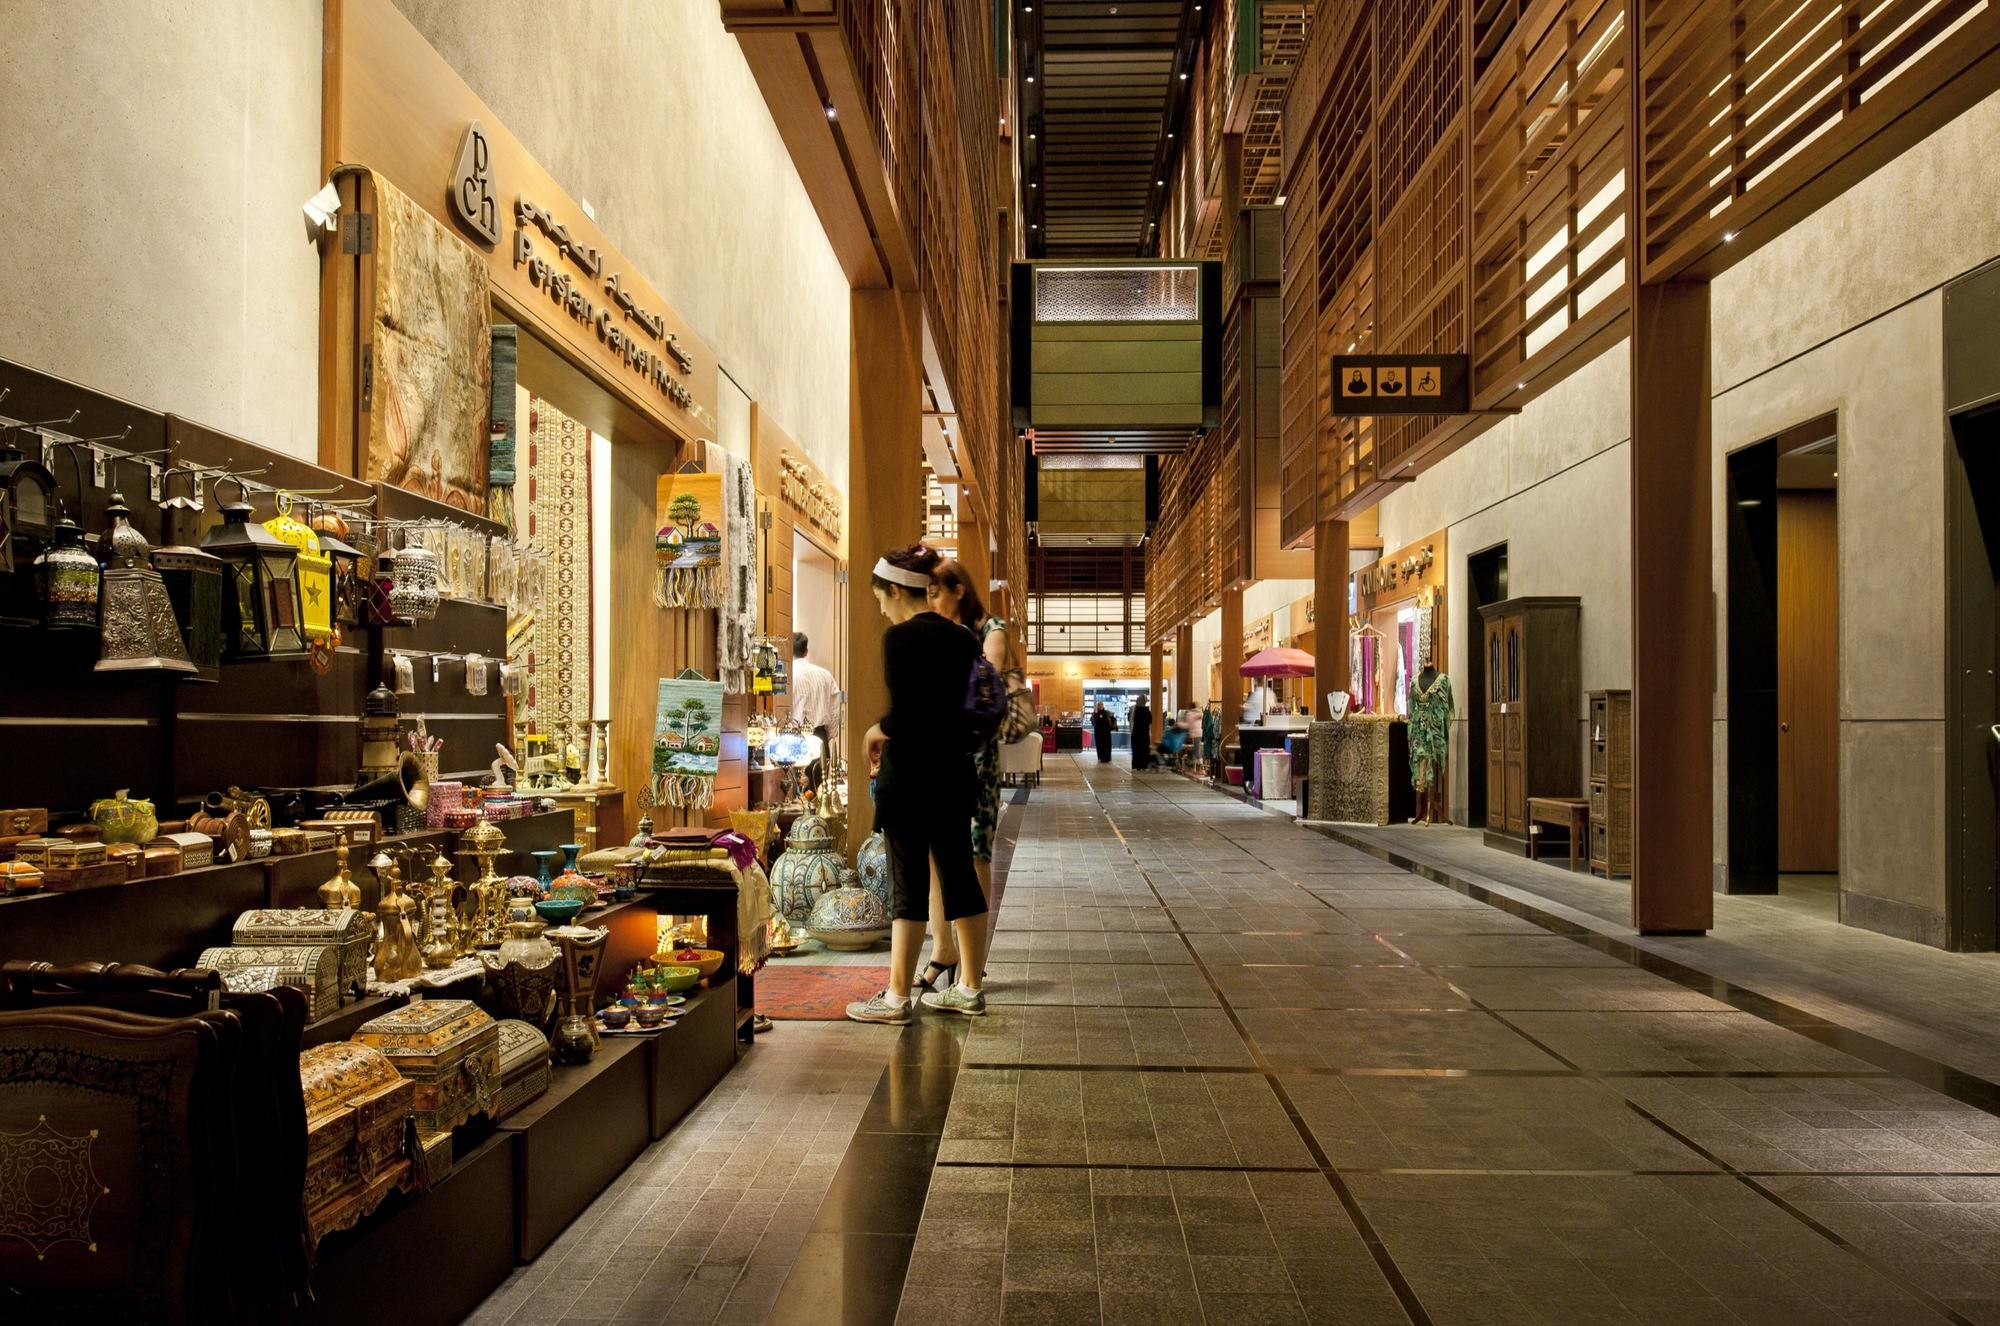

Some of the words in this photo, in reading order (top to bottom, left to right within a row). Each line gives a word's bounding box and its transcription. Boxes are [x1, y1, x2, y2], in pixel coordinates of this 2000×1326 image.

[514, 192, 604, 278] العجمي
[514, 229, 595, 325] Persian
[596, 308, 650, 372] Carpet
[650, 354, 693, 409] House
[604, 271, 666, 341] السجاد
[666, 332, 692, 374] بيت
